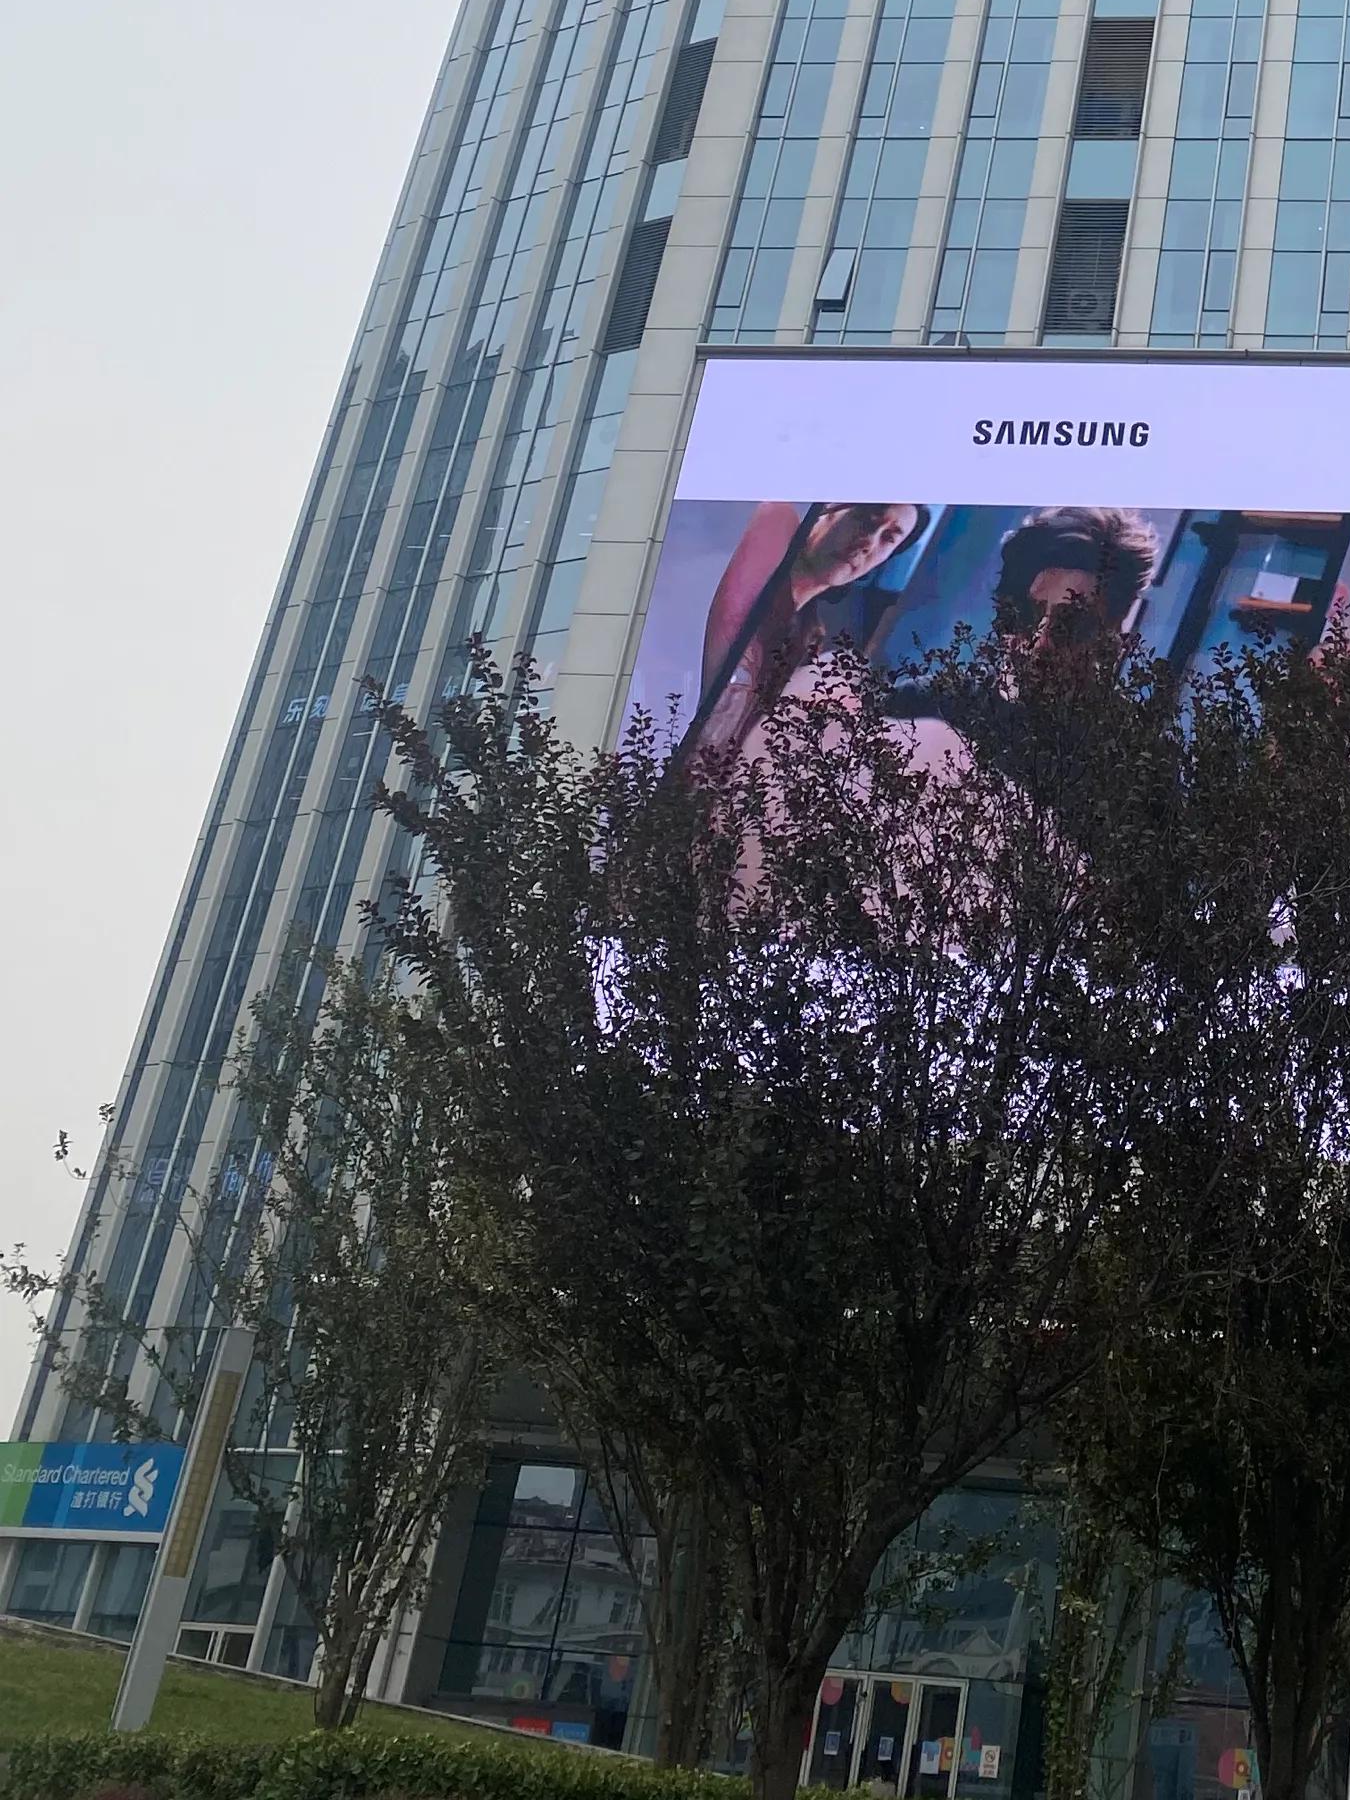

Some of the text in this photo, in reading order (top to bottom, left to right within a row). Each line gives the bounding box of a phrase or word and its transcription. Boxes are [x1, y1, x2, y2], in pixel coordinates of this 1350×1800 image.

[973, 420, 1150, 447] SAMSUNG
[2, 1464, 131, 1486] Standard Chartered
